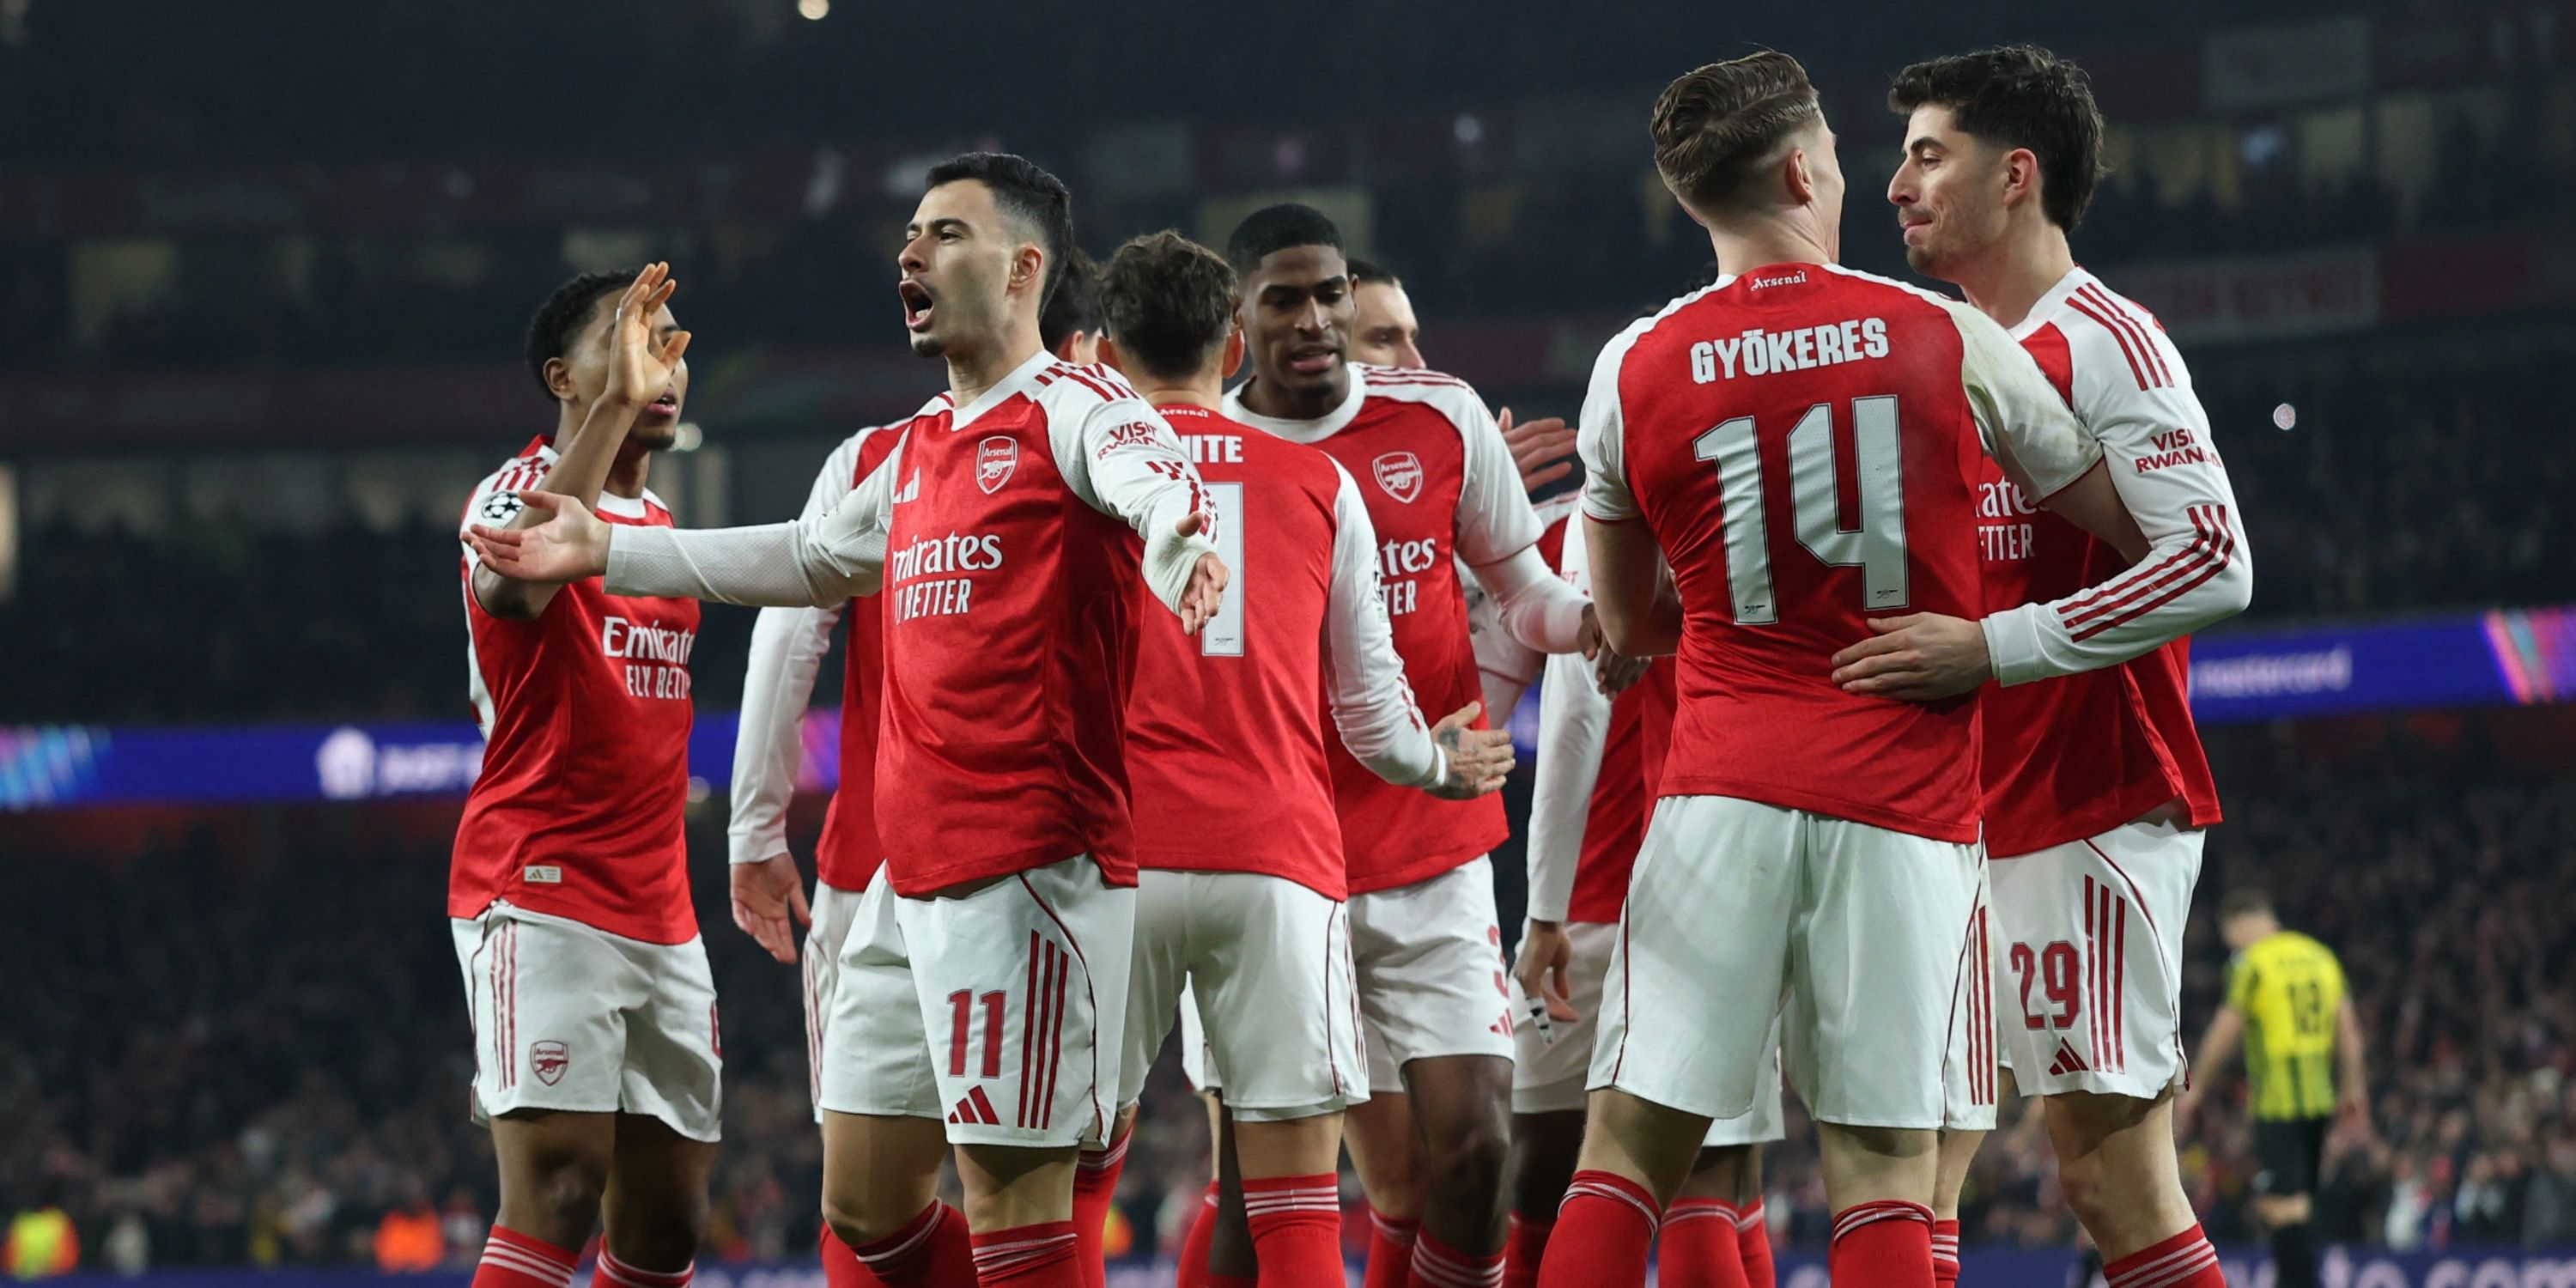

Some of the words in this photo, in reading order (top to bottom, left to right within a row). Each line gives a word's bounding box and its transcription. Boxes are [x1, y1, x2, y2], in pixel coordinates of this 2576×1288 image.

[1750, 270, 1807, 291] Arsenal
[1690, 317, 1889, 385] GYÖKERES
[983, 446, 1014, 458] Arsenal
[1109, 421, 1157, 441] VISIT
[1381, 459, 1414, 472] Arsenal
[1692, 393, 1910, 625] 14
[892, 530, 1004, 586] mirates
[904, 578, 972, 622] BETTER
[625, 664, 652, 698] FLY
[2009, 940, 2081, 1030] 29
[946, 988, 1007, 1079] 11
